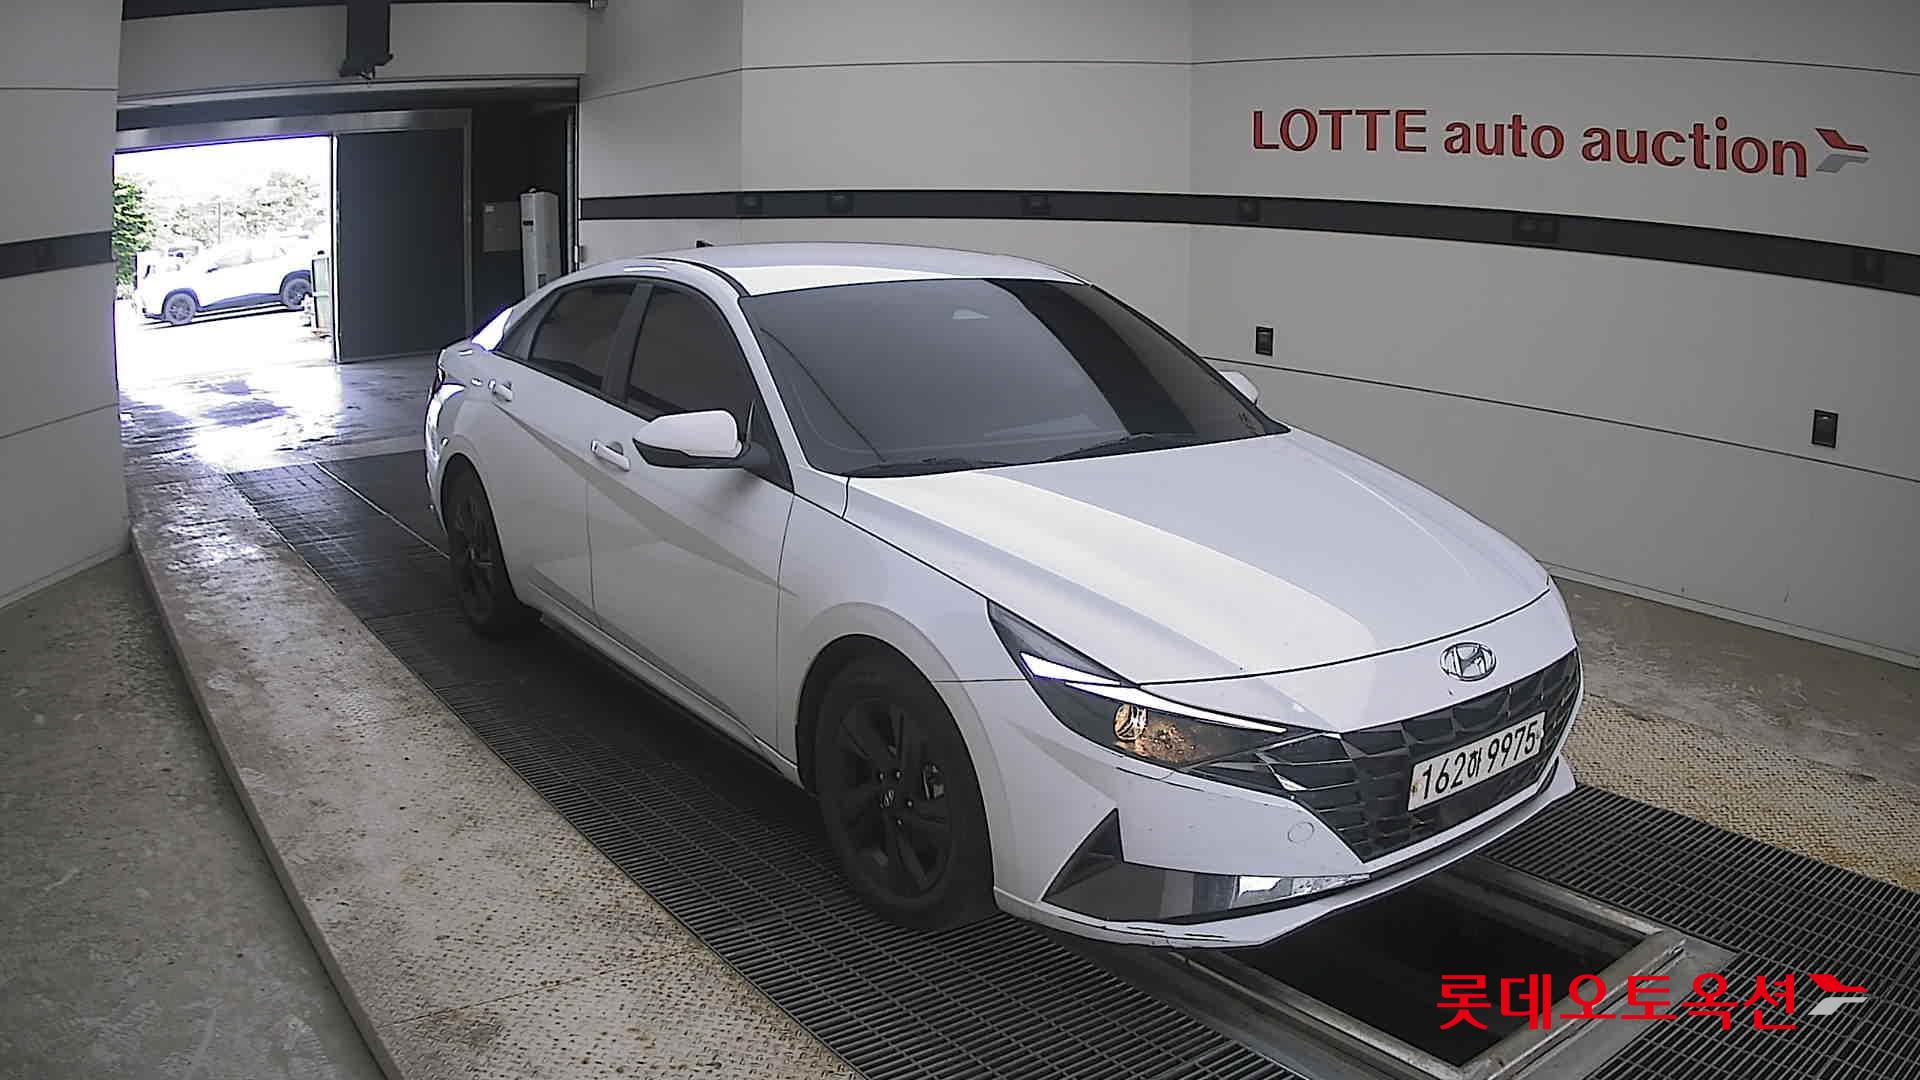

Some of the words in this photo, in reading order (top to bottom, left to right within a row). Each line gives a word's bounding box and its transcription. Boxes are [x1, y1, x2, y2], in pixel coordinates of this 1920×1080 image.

[1252, 109, 1427, 152] LOTTE
[1443, 114, 1566, 159] auto
[1581, 116, 1808, 178] auction
[1486, 719, 1538, 774] 9975
